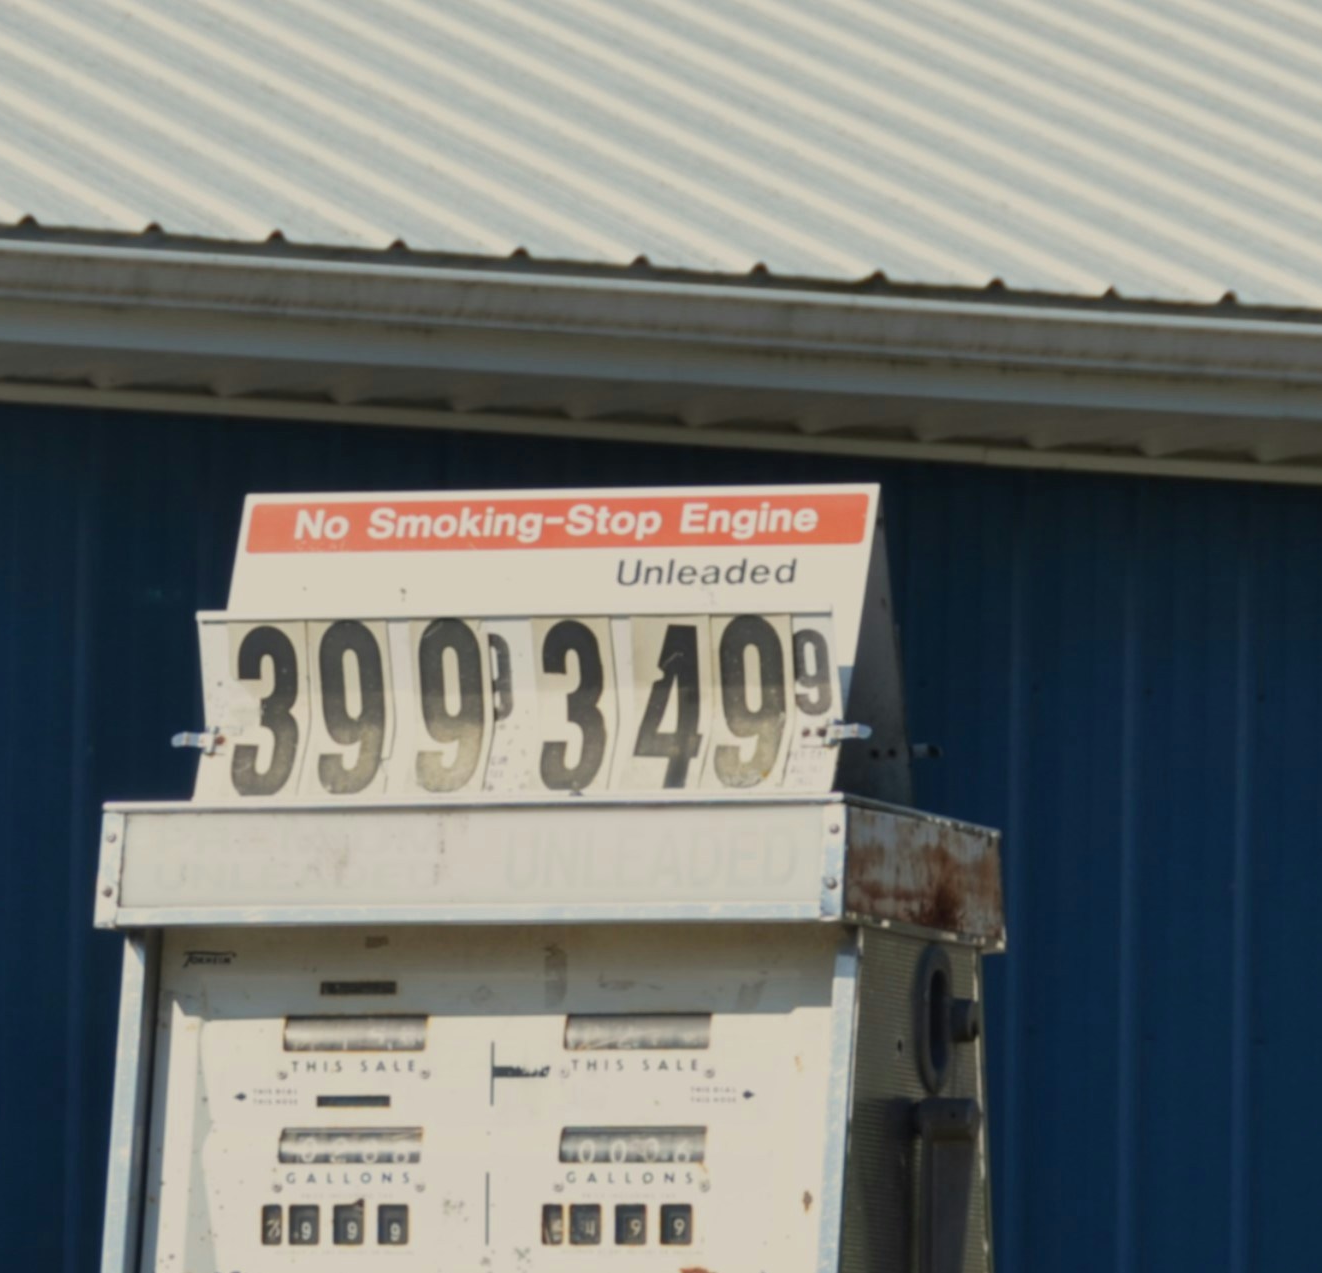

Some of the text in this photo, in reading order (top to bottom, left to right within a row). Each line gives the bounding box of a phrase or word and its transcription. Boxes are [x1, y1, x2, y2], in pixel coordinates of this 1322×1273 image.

[293, 501, 819, 544] No Smoking-Stop Engine
[615, 557, 798, 587] Unleaded
[291, 1060, 416, 1073] THIS SALE
[571, 1059, 699, 1072] THIS SALE
[285, 1171, 410, 1185] GALLONS
[565, 1171, 694, 1185] GALLONS
